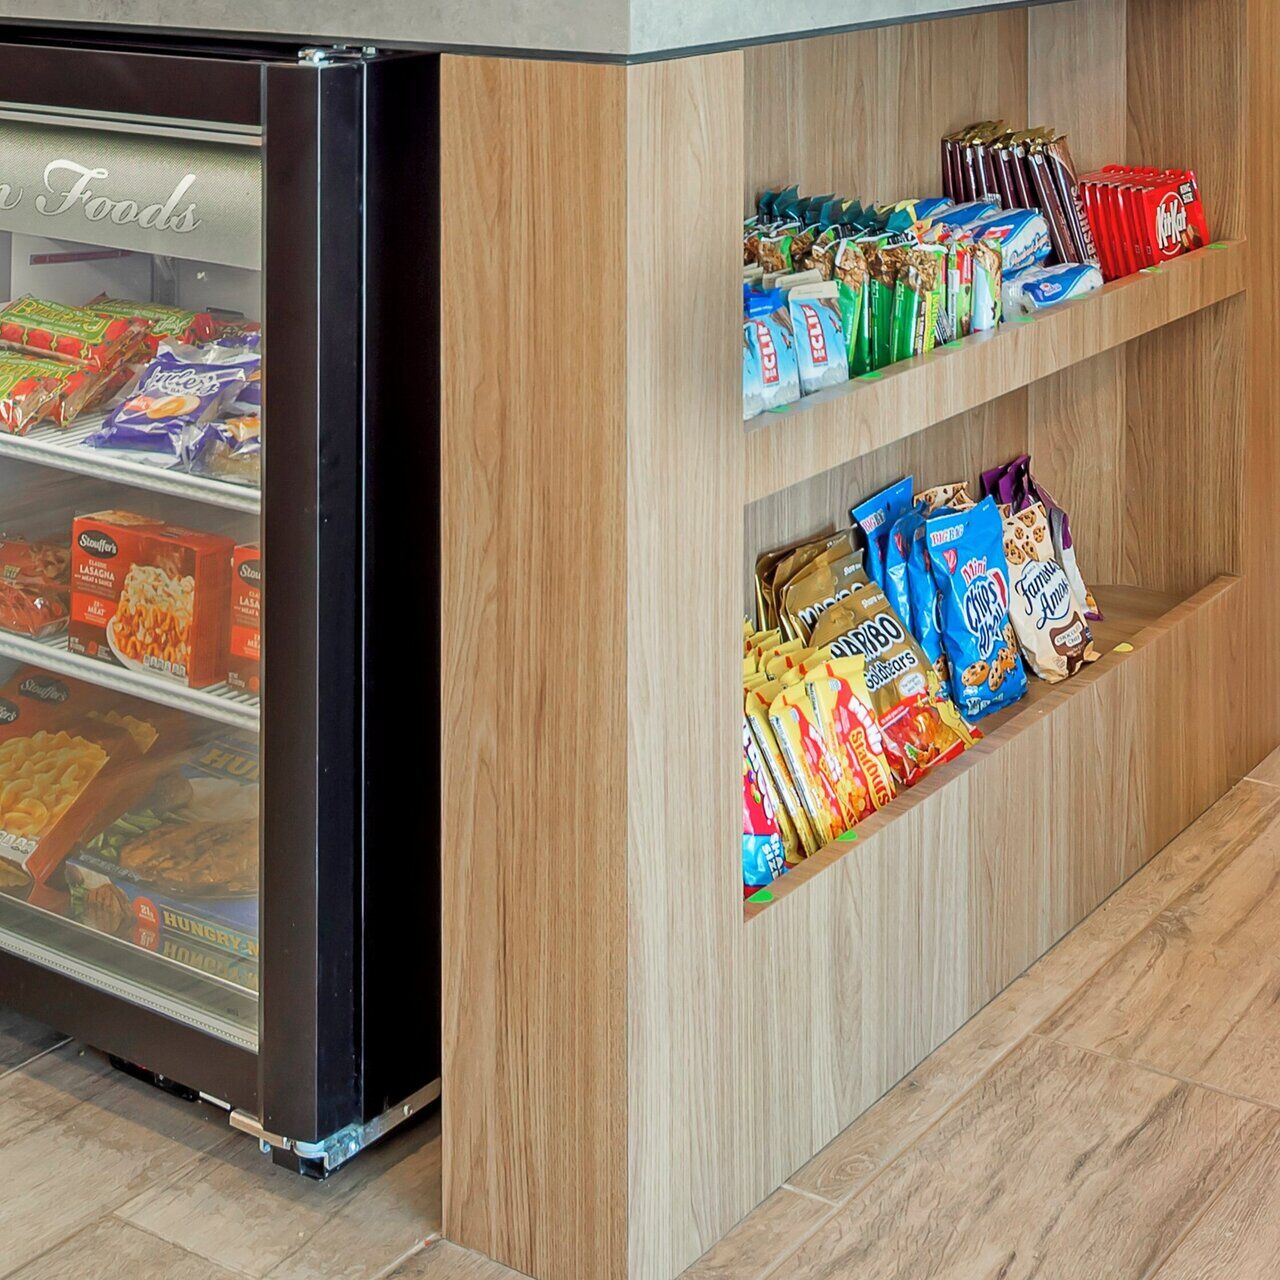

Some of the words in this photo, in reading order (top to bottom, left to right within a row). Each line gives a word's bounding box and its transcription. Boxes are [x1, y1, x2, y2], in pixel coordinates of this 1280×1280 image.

[35, 158, 202, 233] Foods
[1072, 186, 1099, 261] ERSHEY'S
[79, 534, 117, 554] Stouffer's
[930, 532, 948, 547] BIG
[79, 564, 115, 581] LASAGNA
[81, 575, 94, 583] MEAT
[962, 558, 987, 584] Mini
[1015, 558, 1063, 616] Famous
[87, 605, 105, 617] MEAT
[239, 596, 260, 610] LASA
[965, 580, 997, 629] Chips
[1036, 578, 1070, 630] Amos
[831, 614, 905, 662] HARIBO
[20, 678, 68, 702] Stouffer's
[851, 730, 891, 807] Starburs
